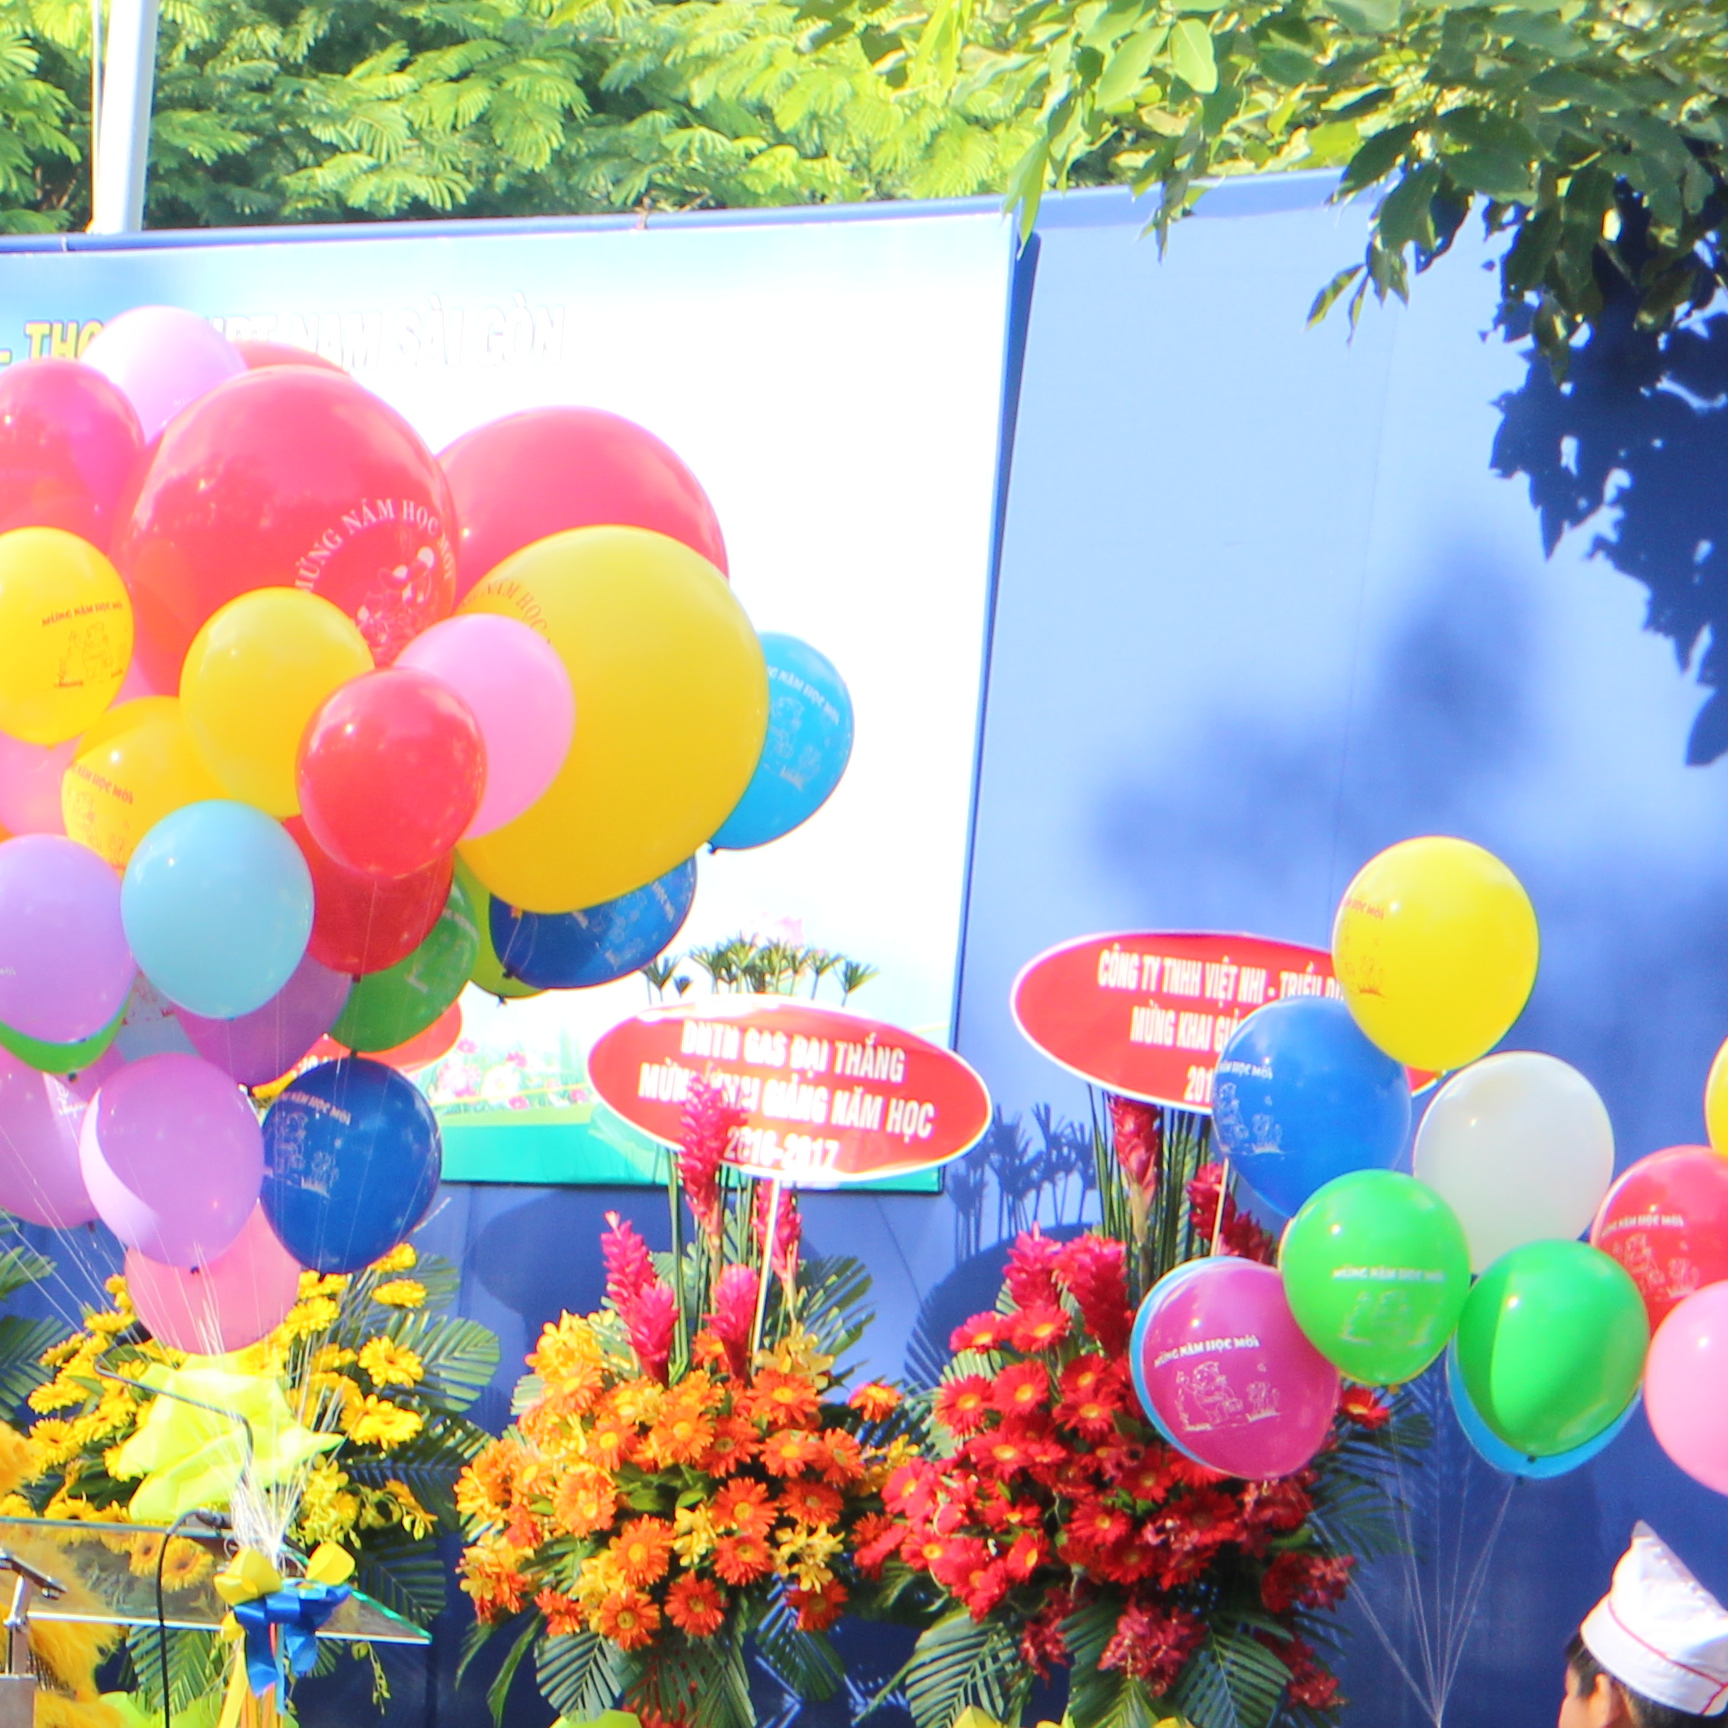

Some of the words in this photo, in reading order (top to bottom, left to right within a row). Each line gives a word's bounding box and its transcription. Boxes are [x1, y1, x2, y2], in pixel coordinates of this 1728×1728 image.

[402, 499, 439, 535] HỌC
[1098, 943, 1139, 990] CÔNG
[1141, 954, 1161, 992] TY
[1162, 957, 1203, 998] TNHH
[1205, 955, 1238, 1008] VIỆT
[1238, 966, 1267, 1005] NHI
[681, 1018, 739, 1060] DNTN
[744, 1026, 786, 1068] GAS
[832, 1031, 905, 1082] THẮNG
[1130, 999, 1176, 1046] MỪNG
[1176, 1011, 1213, 1052] KHAI
[638, 1056, 694, 1102] MỪN
[831, 1084, 884, 1134] NĂM
[887, 1098, 936, 1144] HỌC
[1206, 1337, 1233, 1354] HỌC
[1234, 1333, 1261, 1349] MỚI
